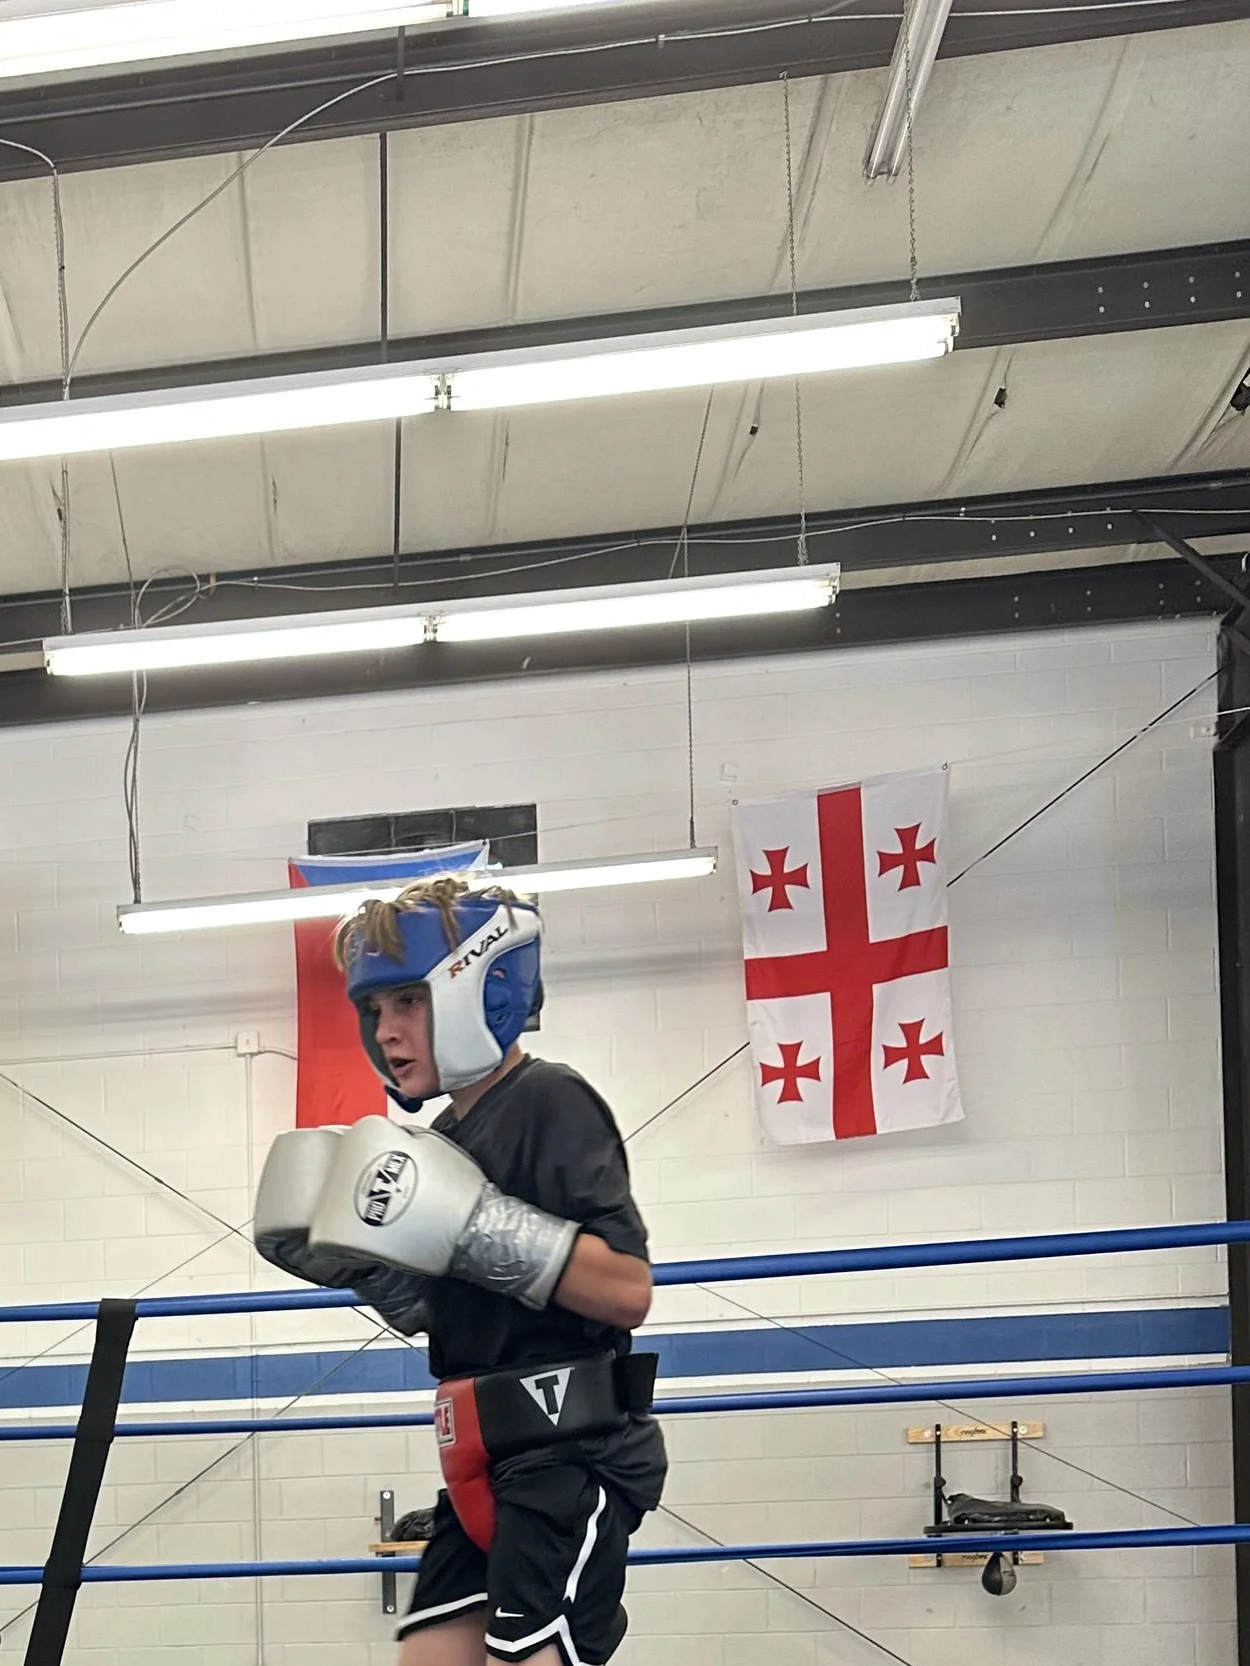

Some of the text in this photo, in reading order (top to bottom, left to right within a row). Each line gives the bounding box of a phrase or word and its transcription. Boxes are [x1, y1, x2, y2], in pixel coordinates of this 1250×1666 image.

[447, 926, 509, 979] RIVAL
[365, 1200, 387, 1222] PRO
[384, 1153, 408, 1175] MEX
[534, 1374, 560, 1415] T
